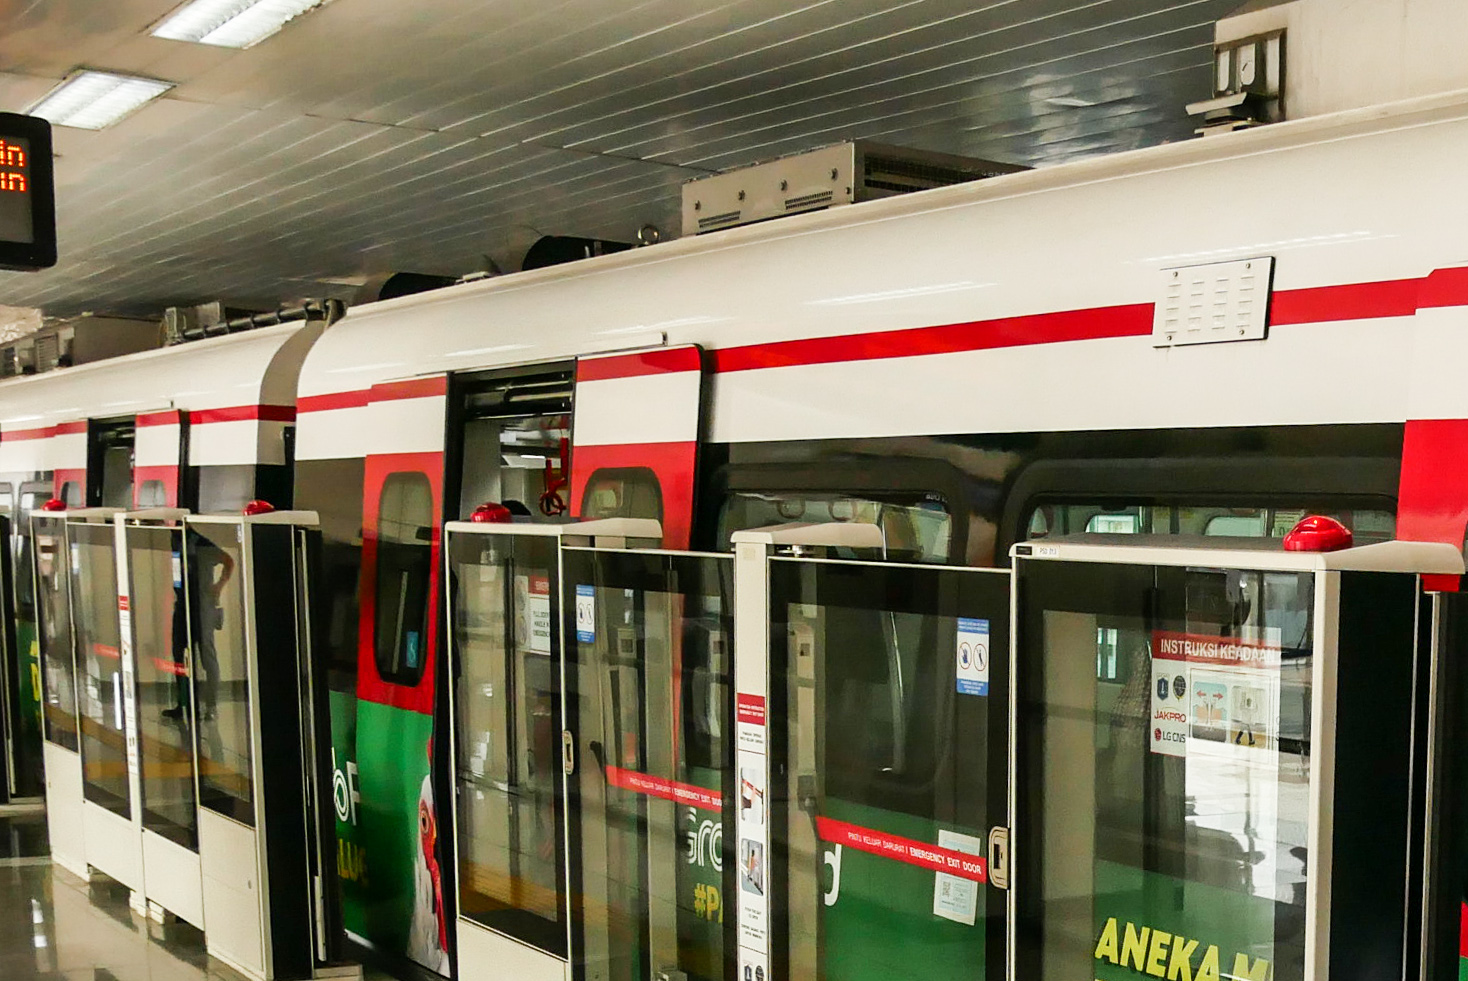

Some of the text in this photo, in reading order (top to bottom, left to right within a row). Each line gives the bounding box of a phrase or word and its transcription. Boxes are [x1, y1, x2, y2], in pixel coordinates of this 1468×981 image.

[1160, 638, 1276, 663] INSTRUKSI KEADAAN
[1154, 709, 1187, 723] JAKPRO
[1162, 728, 1186, 743] LG CNS
[909, 846, 945, 865] EMERGENCY
[947, 857, 961, 869] EXIT
[962, 861, 982, 875] DOOR
